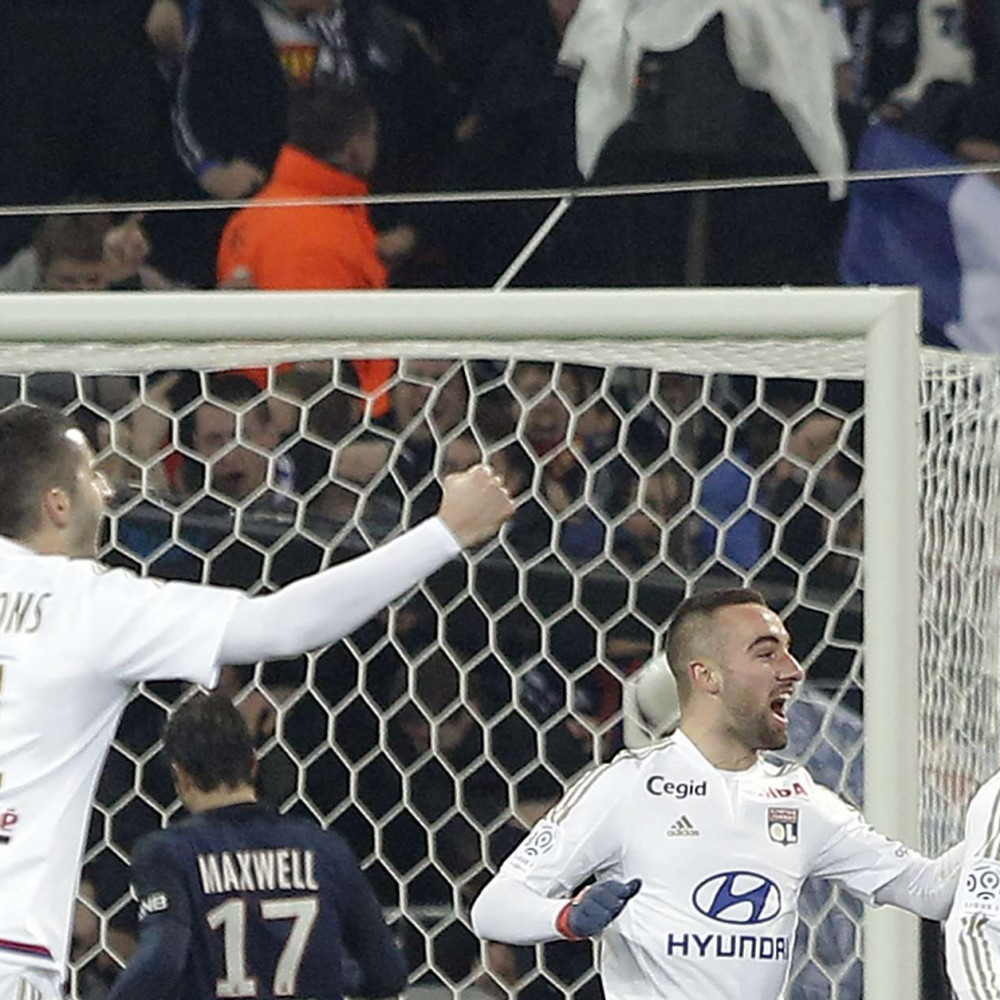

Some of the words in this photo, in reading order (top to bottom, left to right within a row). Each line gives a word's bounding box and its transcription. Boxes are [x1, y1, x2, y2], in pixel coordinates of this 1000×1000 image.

[646, 775, 708, 799] Cegid
[199, 848, 319, 894] MAXWELL
[206, 897, 319, 998] 17
